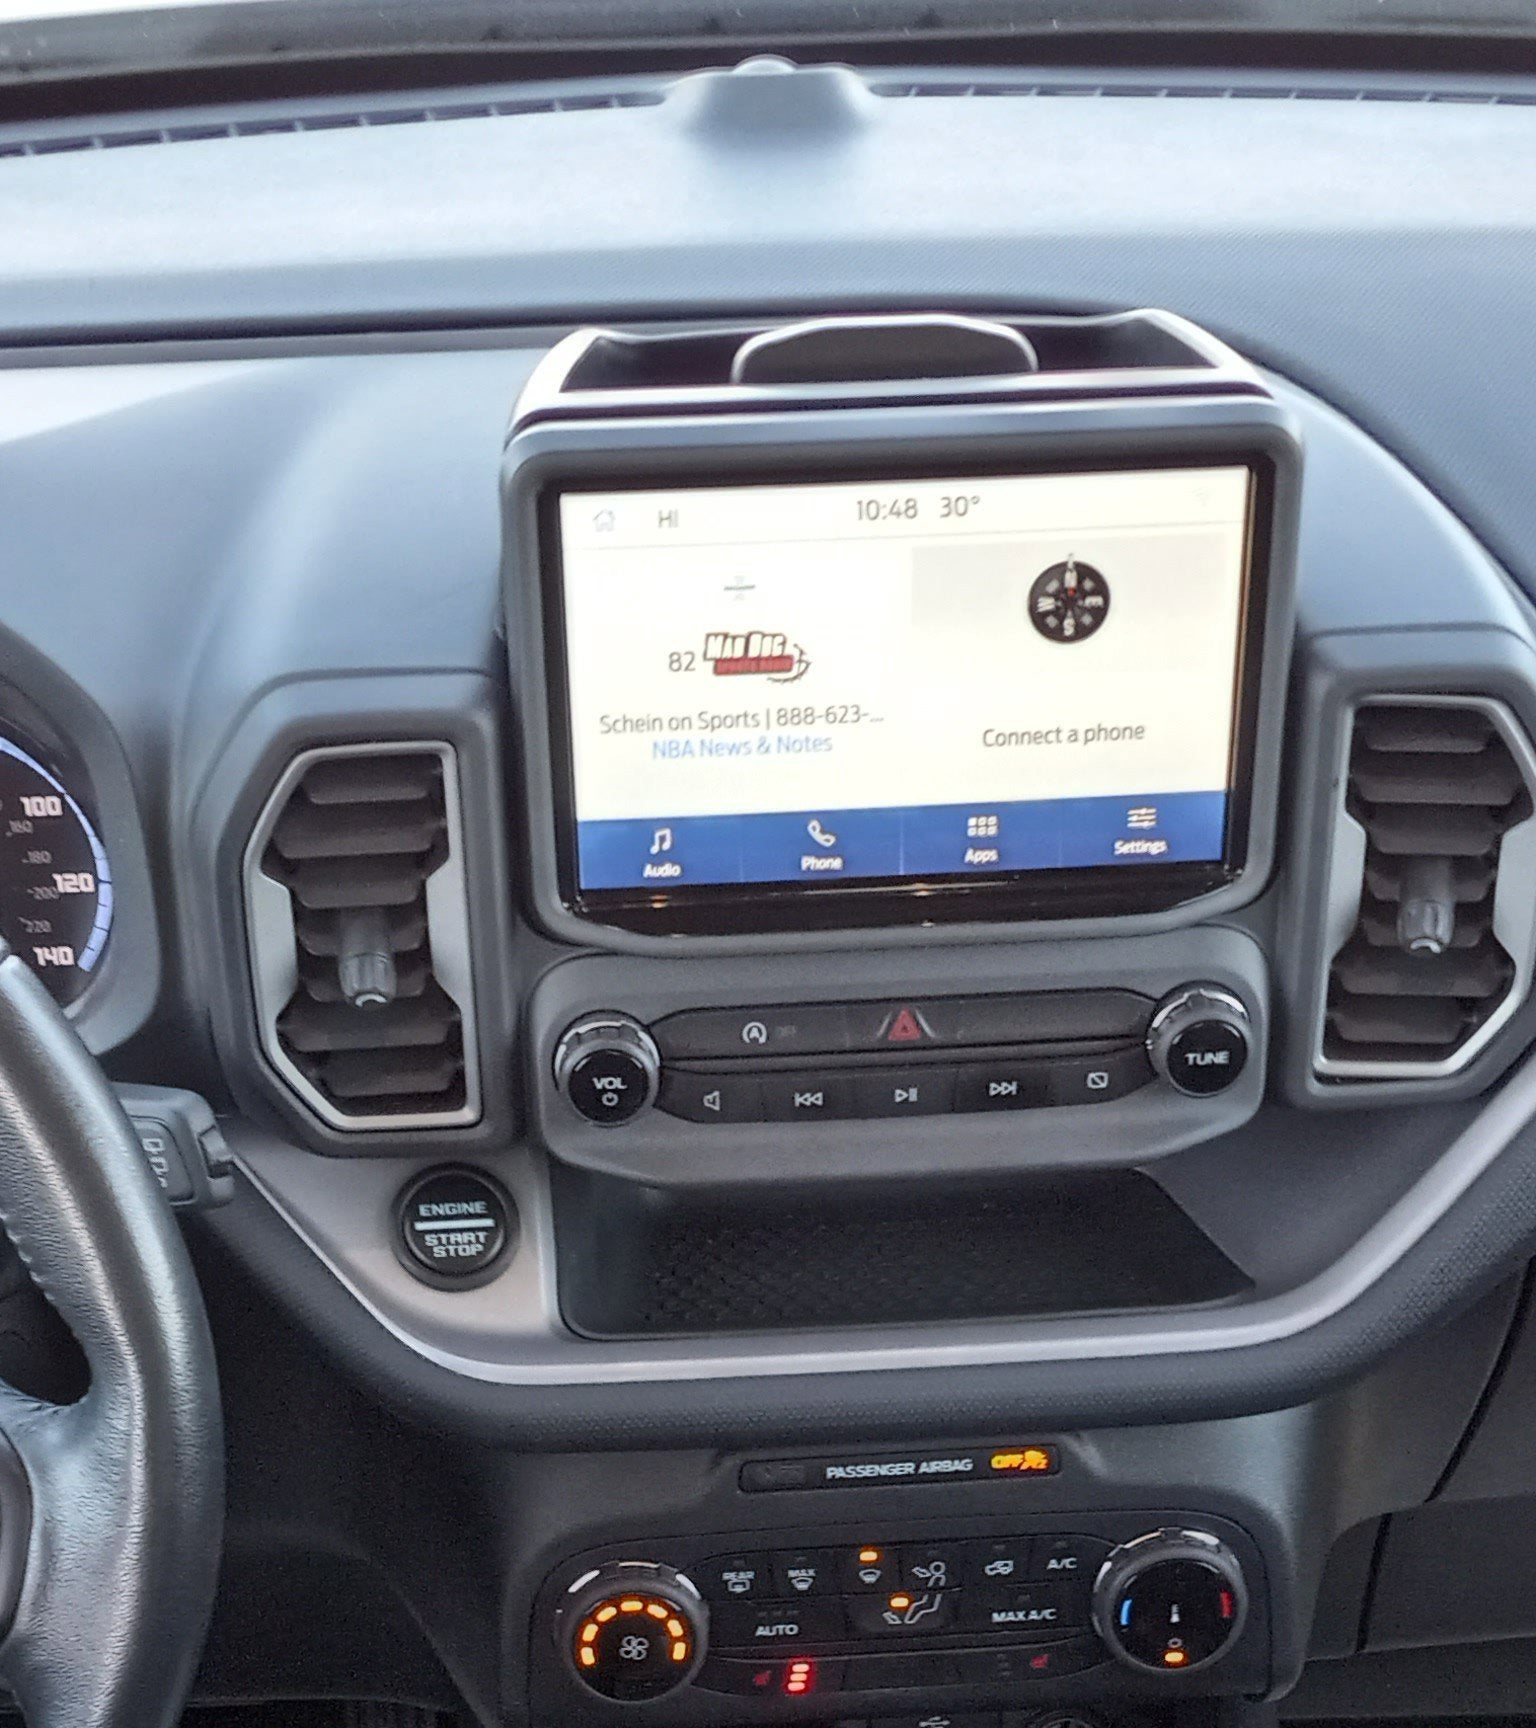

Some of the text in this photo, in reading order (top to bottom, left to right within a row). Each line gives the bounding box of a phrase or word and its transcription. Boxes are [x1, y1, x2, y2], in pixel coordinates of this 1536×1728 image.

[856, 495, 981, 521] 10:48 30°
[668, 651, 696, 672] 82
[599, 714, 663, 735] Schein
[667, 716, 693, 732] on
[697, 710, 761, 733] Sports
[982, 723, 1146, 748] Connect a phone
[652, 735, 833, 759] NBA News & Notes
[20, 795, 63, 817] 100
[964, 848, 999, 864] Apps
[1114, 839, 1168, 856] Settings
[643, 863, 682, 879] Audio
[800, 855, 844, 872] Phone
[51, 872, 96, 894] 120
[32, 945, 76, 967] 140
[1184, 1050, 1231, 1067] TUNE
[592, 1076, 628, 1090] VOL
[418, 1201, 488, 1217] ENGINE
[424, 1231, 489, 1247] START
[432, 1243, 484, 1258] STOP
[825, 1458, 974, 1480] PASSENGER AIRBAG
[1046, 1557, 1077, 1570] A/C
[991, 1608, 1058, 1623] MAX A/C
[754, 1623, 800, 1636] AUTO
